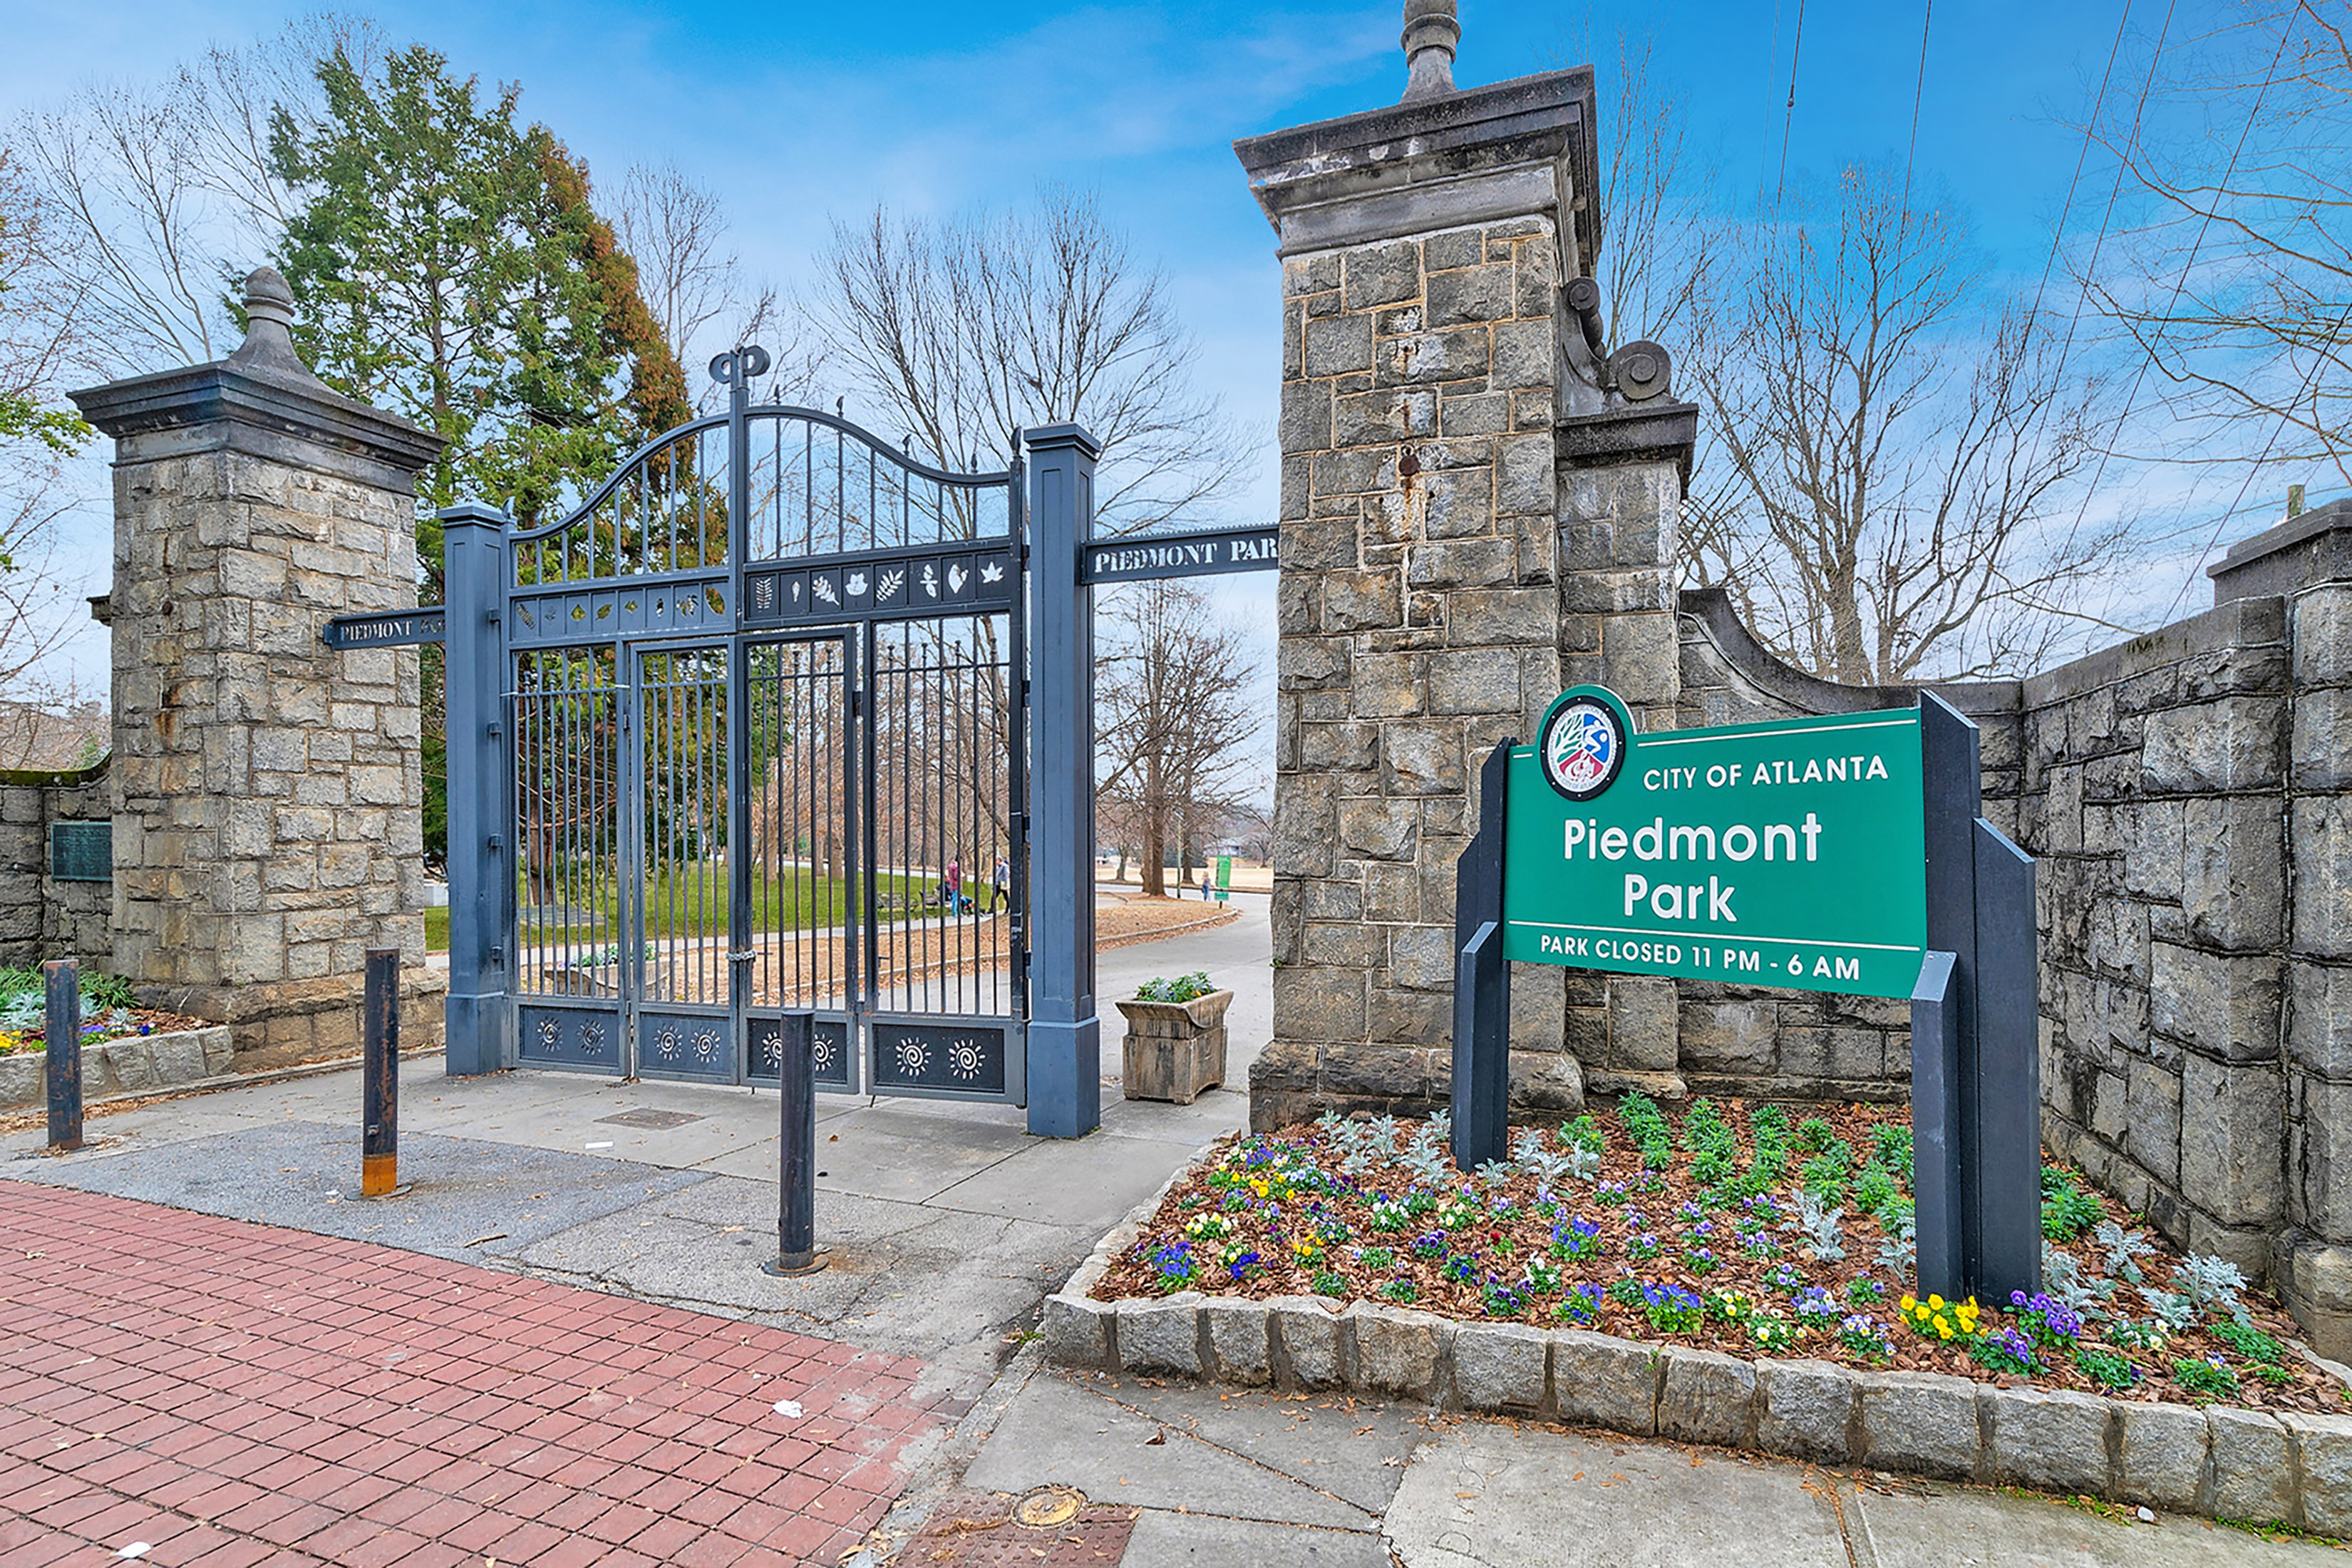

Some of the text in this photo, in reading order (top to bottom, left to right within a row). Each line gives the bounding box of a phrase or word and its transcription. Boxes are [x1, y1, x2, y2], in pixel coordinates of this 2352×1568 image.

[1095, 537, 1278, 573] PIEDMONT PAR
[341, 617, 445, 641] PIEDMONT PAR
[1643, 754, 1889, 792] CITY OF ATLANTA
[1563, 812, 1823, 862] Piedmont
[1624, 873, 1738, 923] Park
[1540, 934, 1589, 957] PARK
[1594, 938, 1682, 965] CLOSED
[1691, 946, 1711, 969] 11
[1723, 949, 1760, 973] PM
[1787, 954, 1804, 976] 6
[1811, 956, 1860, 981] AM
